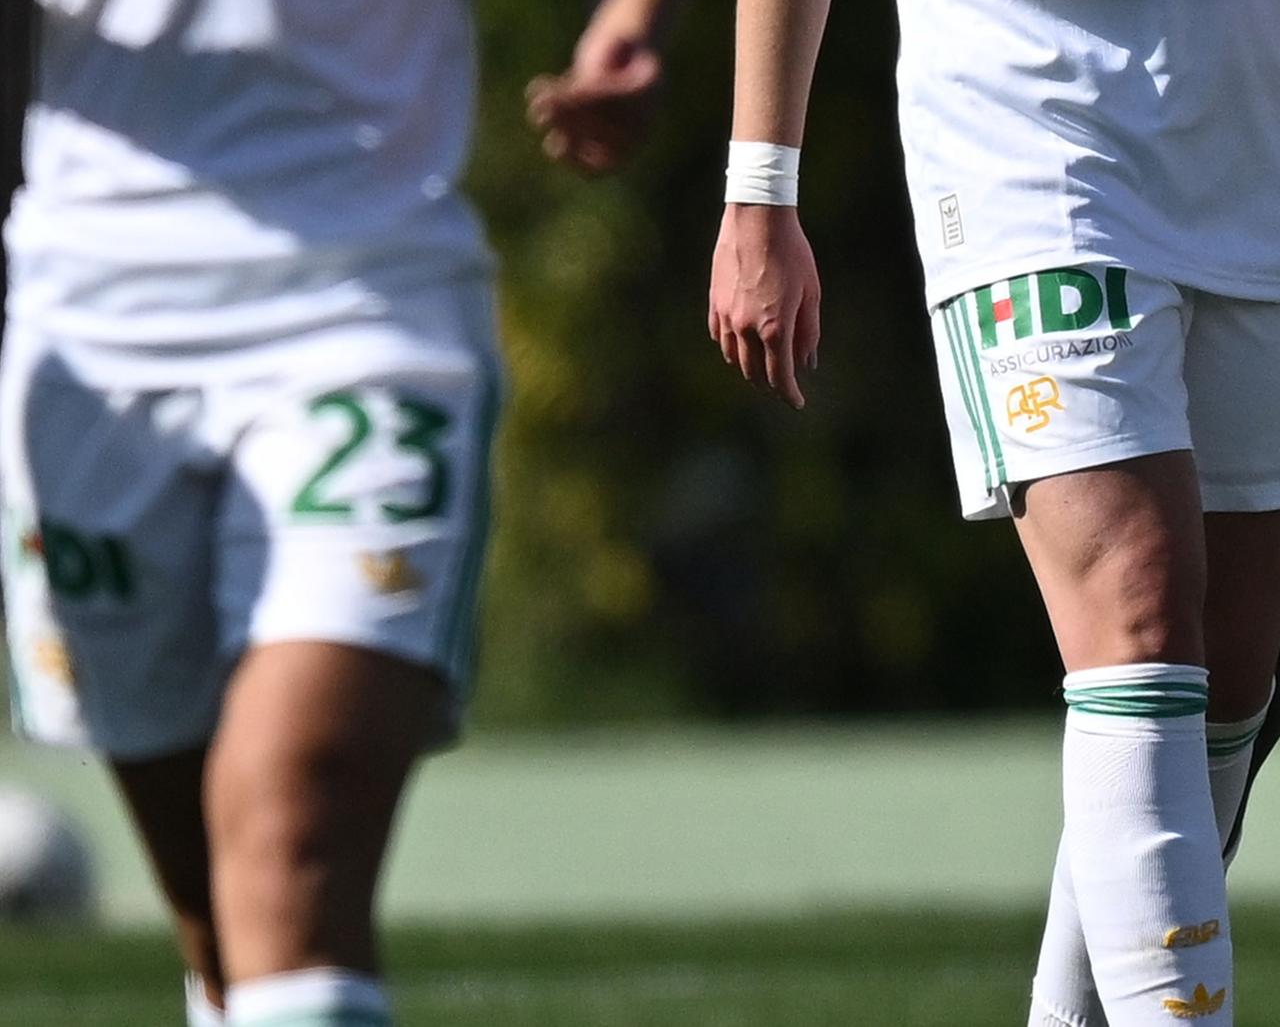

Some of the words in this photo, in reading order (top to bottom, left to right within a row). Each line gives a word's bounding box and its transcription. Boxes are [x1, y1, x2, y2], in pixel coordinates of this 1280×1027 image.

[975, 267, 1132, 350] HDI
[990, 333, 1134, 376] ASSICURAZIONI
[293, 389, 452, 523] 23
